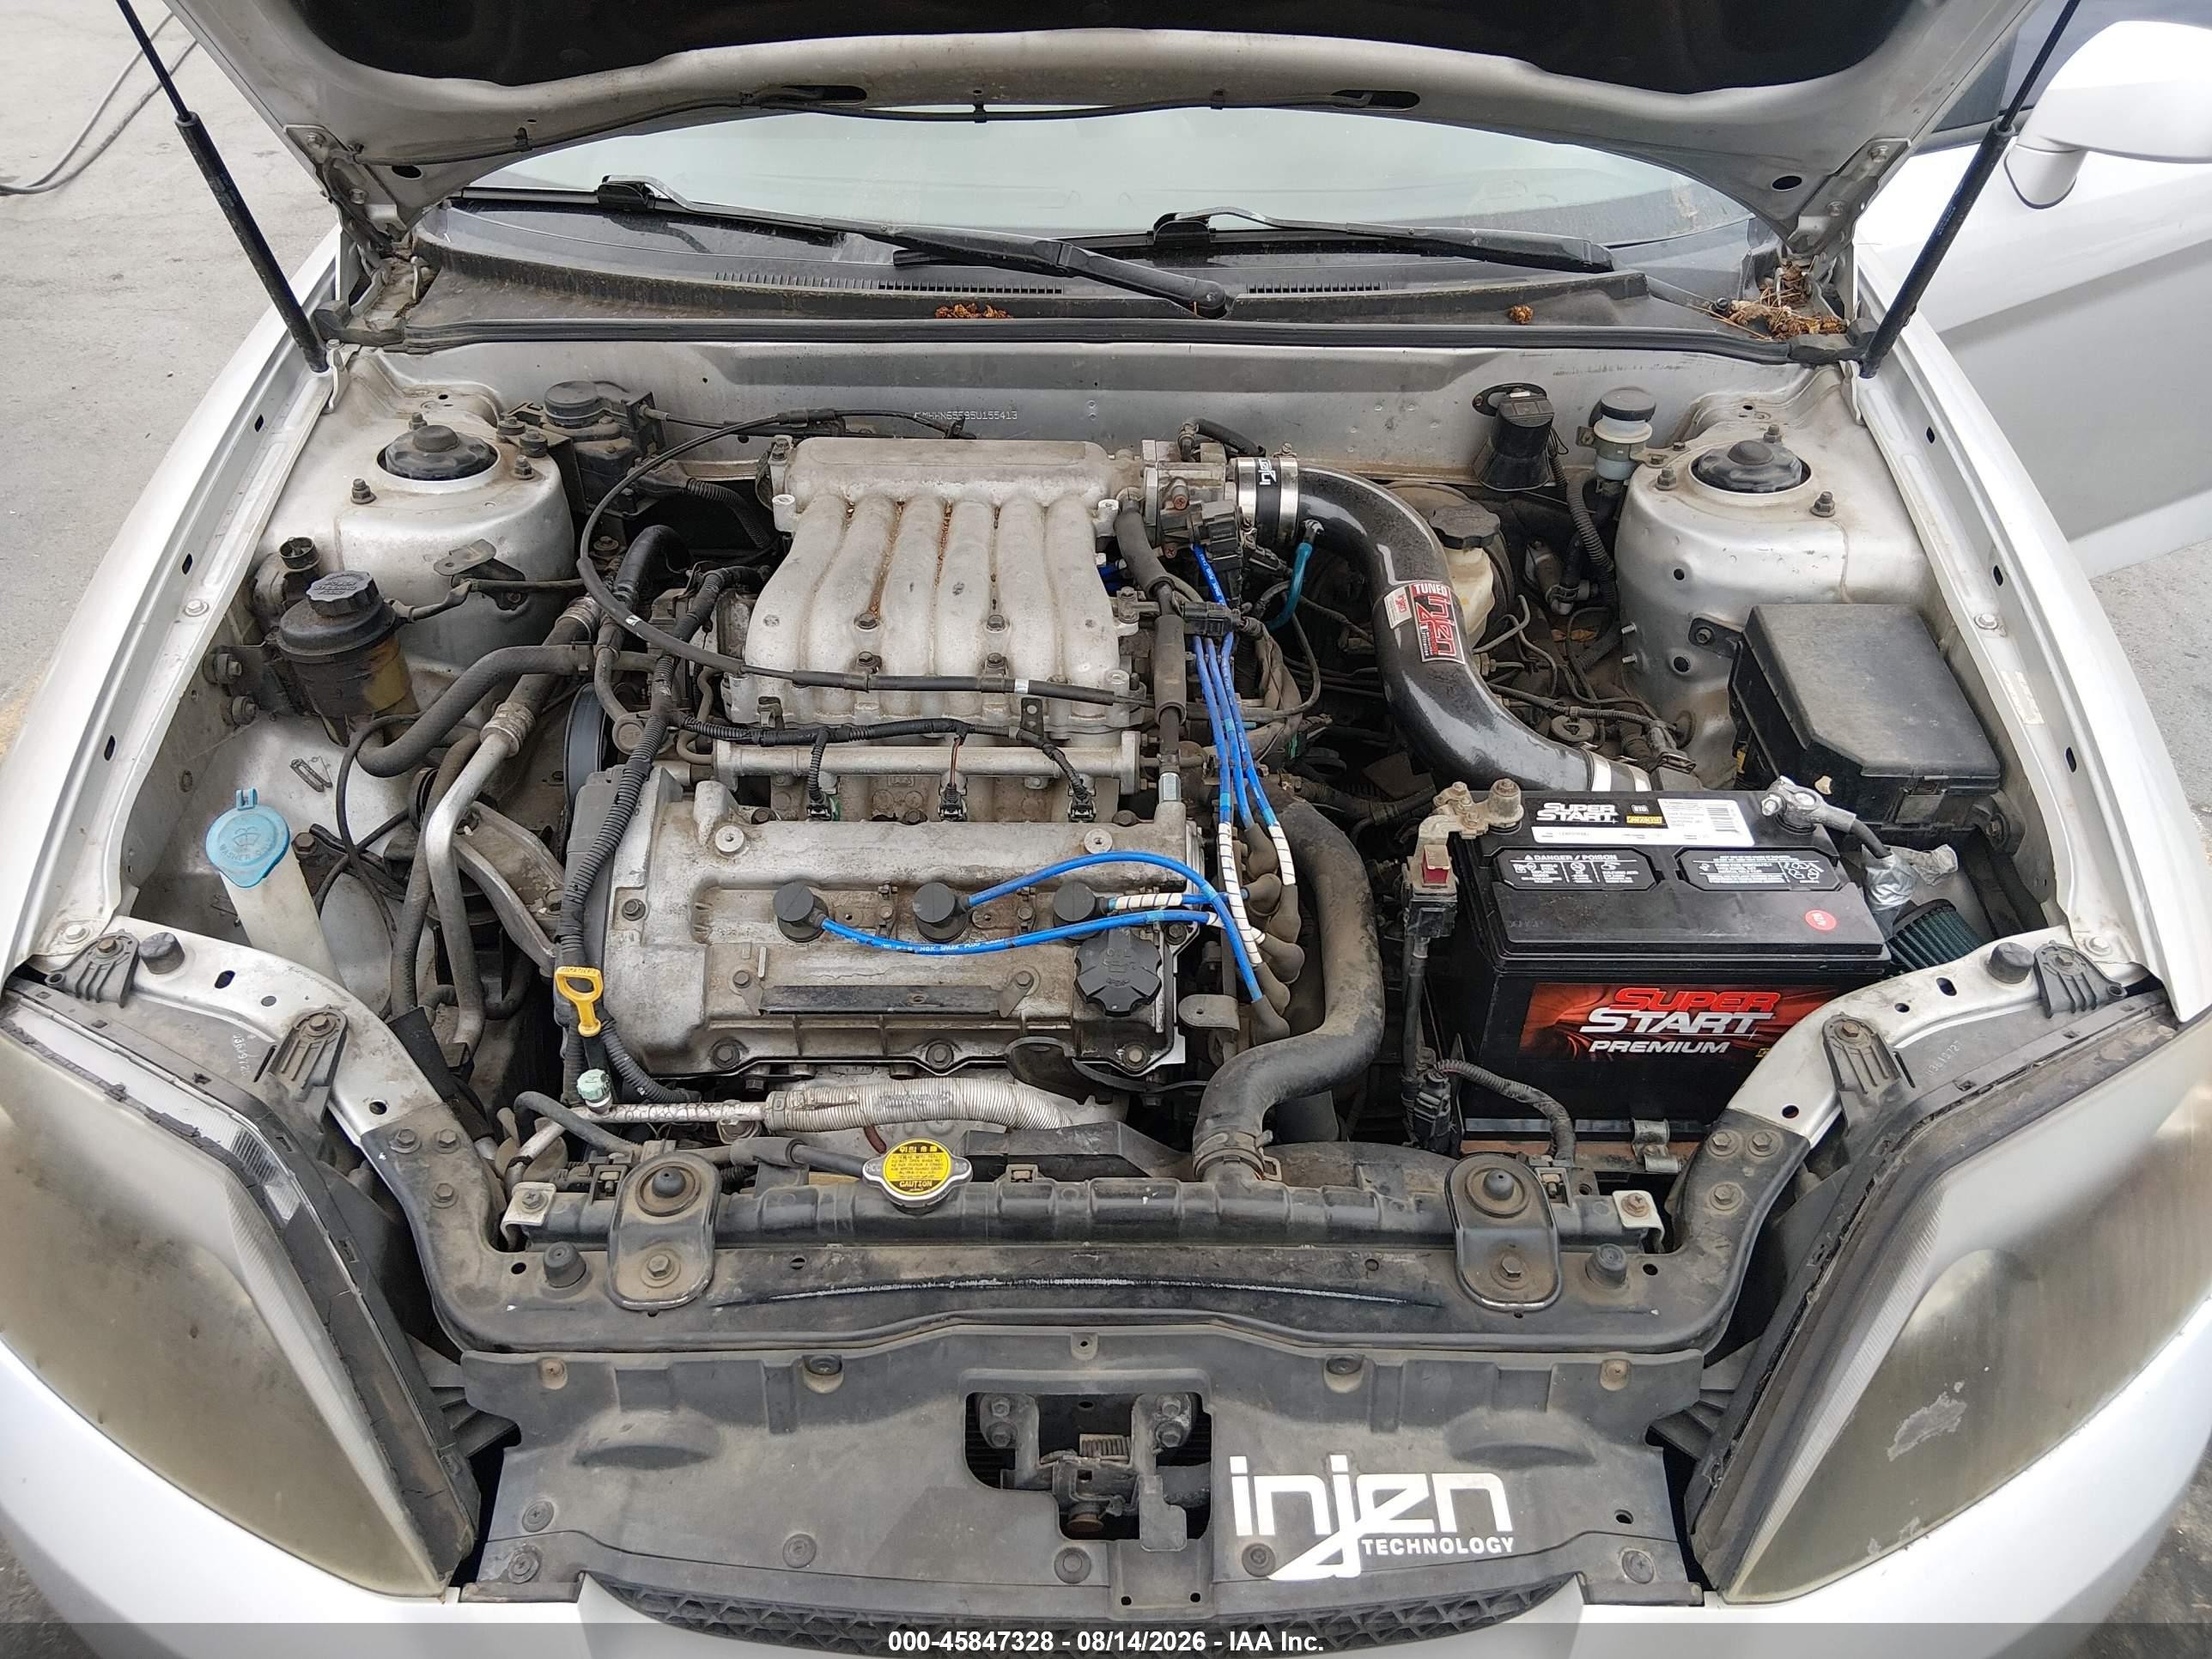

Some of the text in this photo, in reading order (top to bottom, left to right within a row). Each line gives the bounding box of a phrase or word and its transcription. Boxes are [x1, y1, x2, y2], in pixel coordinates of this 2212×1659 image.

[1413, 584, 1447, 595] TUNED
[1543, 802, 1615, 812] SUPER
[1536, 810, 1619, 823] START
[1610, 988, 1780, 1011] SUPER
[1581, 1009, 1774, 1035] START
[1589, 1040, 1729, 1054] PREMIUM
[1230, 1455, 1514, 1581] injen
[1361, 1536, 1514, 1556] TECHNOLOGY
